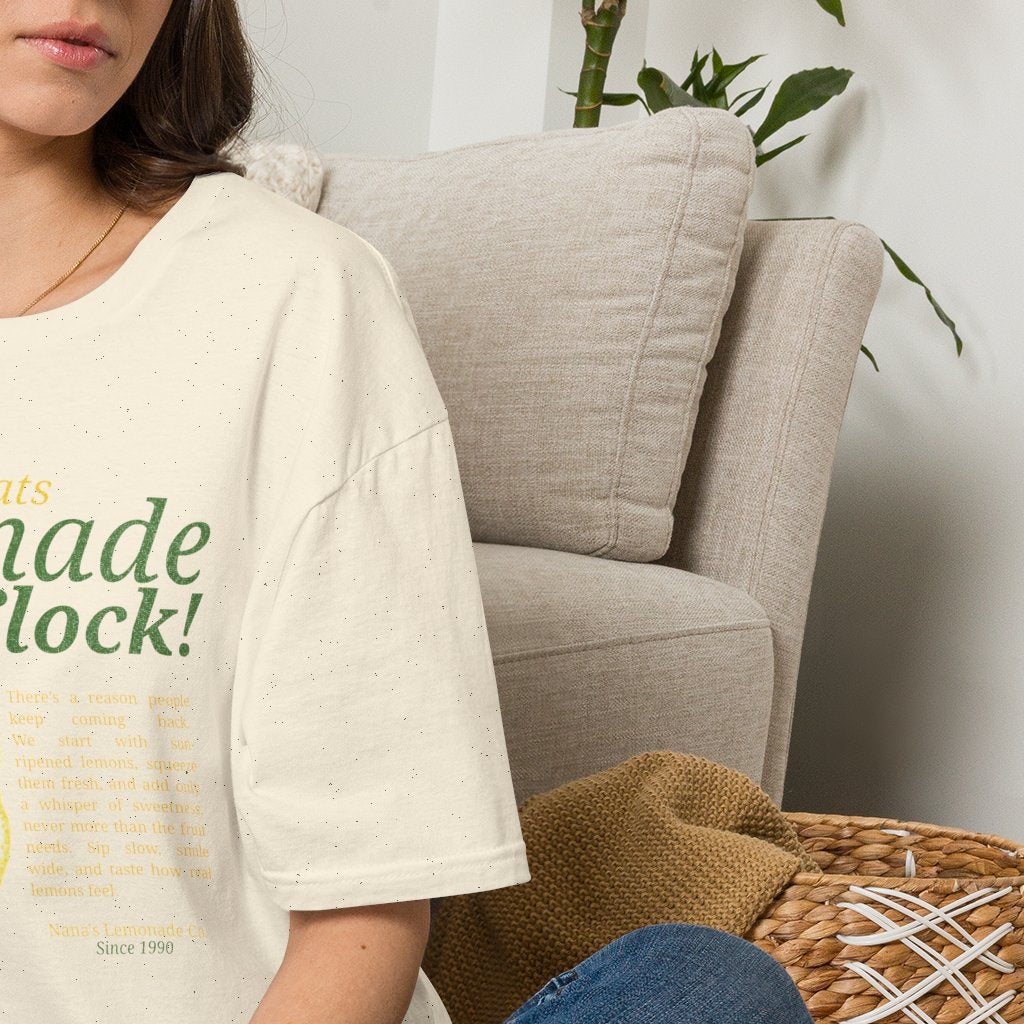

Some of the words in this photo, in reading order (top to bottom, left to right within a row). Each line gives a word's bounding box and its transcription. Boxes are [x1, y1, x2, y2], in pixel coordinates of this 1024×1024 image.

[7, 690, 60, 704] There's
[70, 694, 77, 704] a
[88, 694, 137, 705] reason
[148, 694, 190, 710] people
[9, 712, 44, 728] keep
[72, 713, 126, 729] coming
[12, 734, 35, 746] We
[59, 735, 92, 748] start
[115, 734, 148, 749] with
[15, 755, 72, 771] ripened
[146, 760, 198, 774] squeeze
[18, 776, 55, 790] them
[109, 777, 136, 791] and
[143, 778, 169, 791] add
[176, 781, 200, 796] only
[21, 801, 29, 811] a
[39, 797, 97, 814] whisper
[109, 798, 124, 811] of
[24, 822, 64, 832] never
[71, 822, 108, 833] more
[113, 819, 147, 833] than
[152, 820, 175, 835] the
[87, 841, 110, 858] Sip
[176, 844, 209, 858] smile
[28, 862, 68, 877] wide,
[75, 862, 102, 876] and
[110, 864, 144, 876] taste
[151, 863, 181, 877] how
[31, 883, 84, 897] lemons
[48, 922, 100, 938] Nana's
[104, 922, 184, 938] Lemonade
[96, 941, 135, 955] Since
[140, 940, 174, 955] 1990
